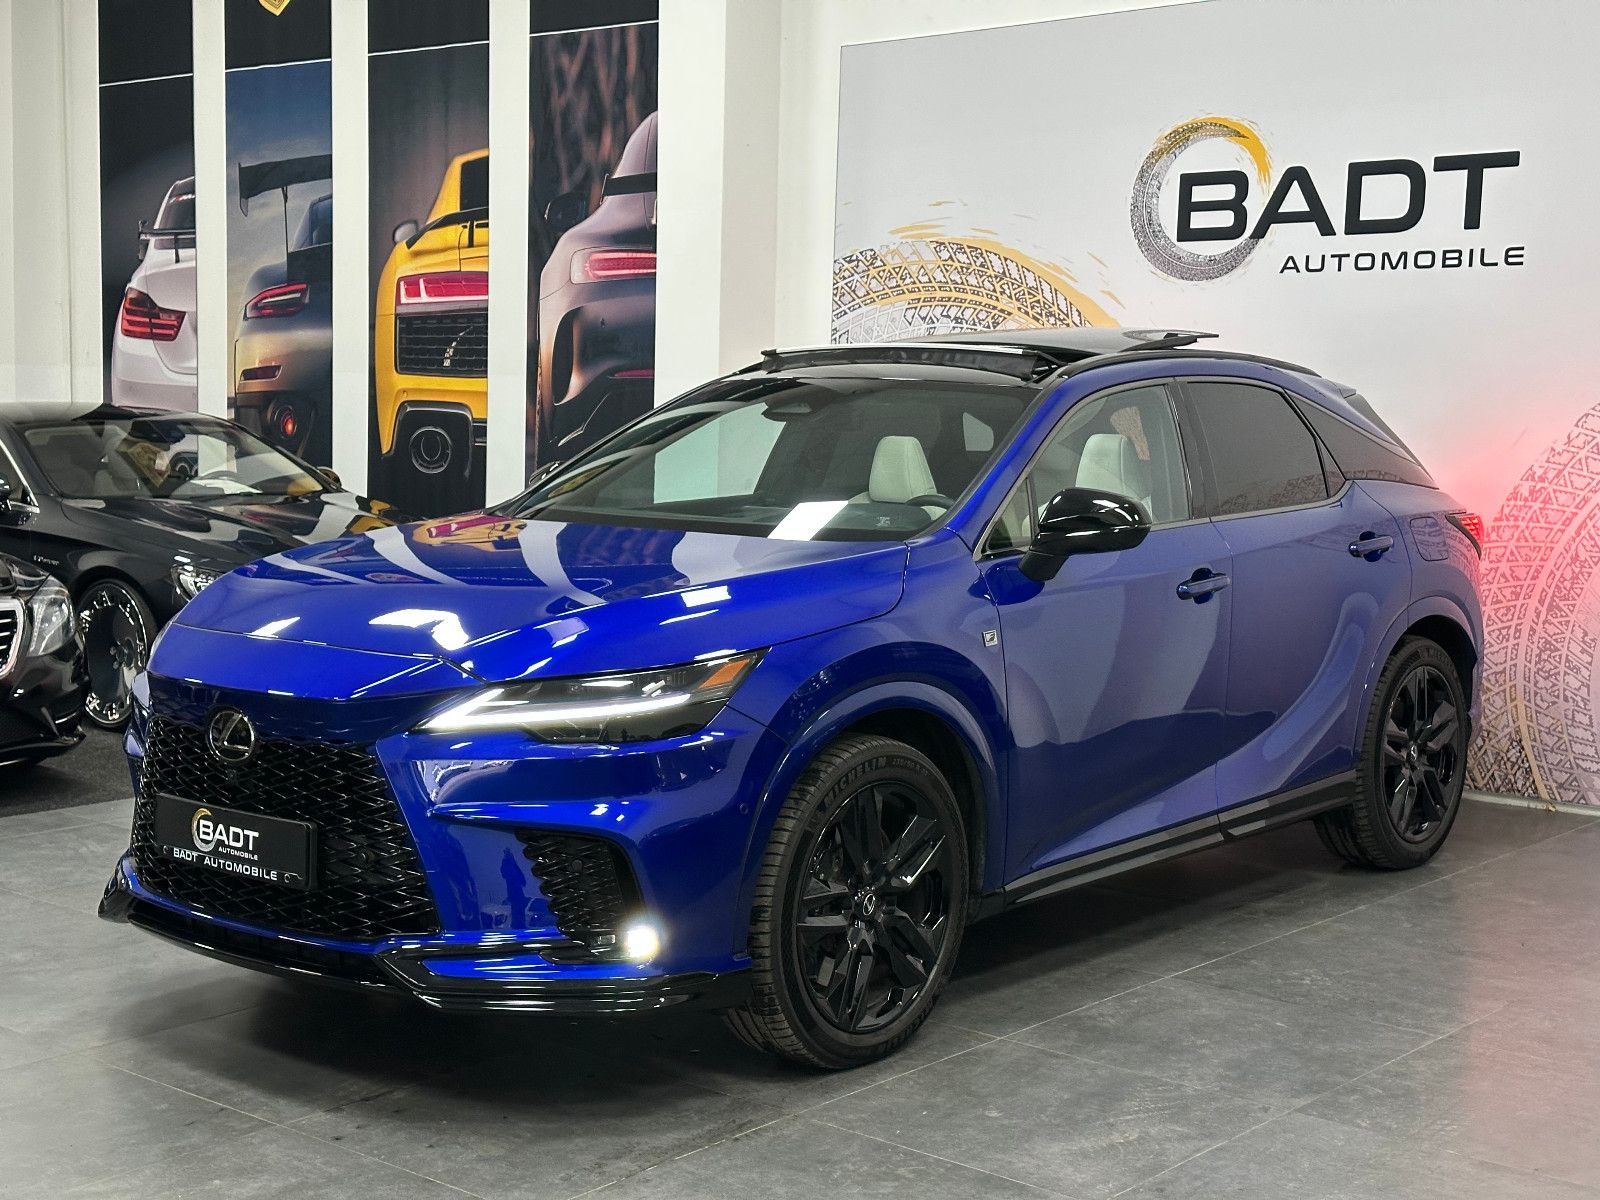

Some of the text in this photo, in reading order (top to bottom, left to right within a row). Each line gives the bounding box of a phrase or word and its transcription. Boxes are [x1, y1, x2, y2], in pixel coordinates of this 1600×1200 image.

[1176, 150, 1520, 242] BADT
[1279, 246, 1525, 274] AUTOMOBILE
[824, 756, 886, 808] MICHELIN
[199, 819, 259, 850] BADT
[173, 847, 278, 881] BADT AUTOMOBILE
[218, 846, 259, 861] AUTOMOBILE
